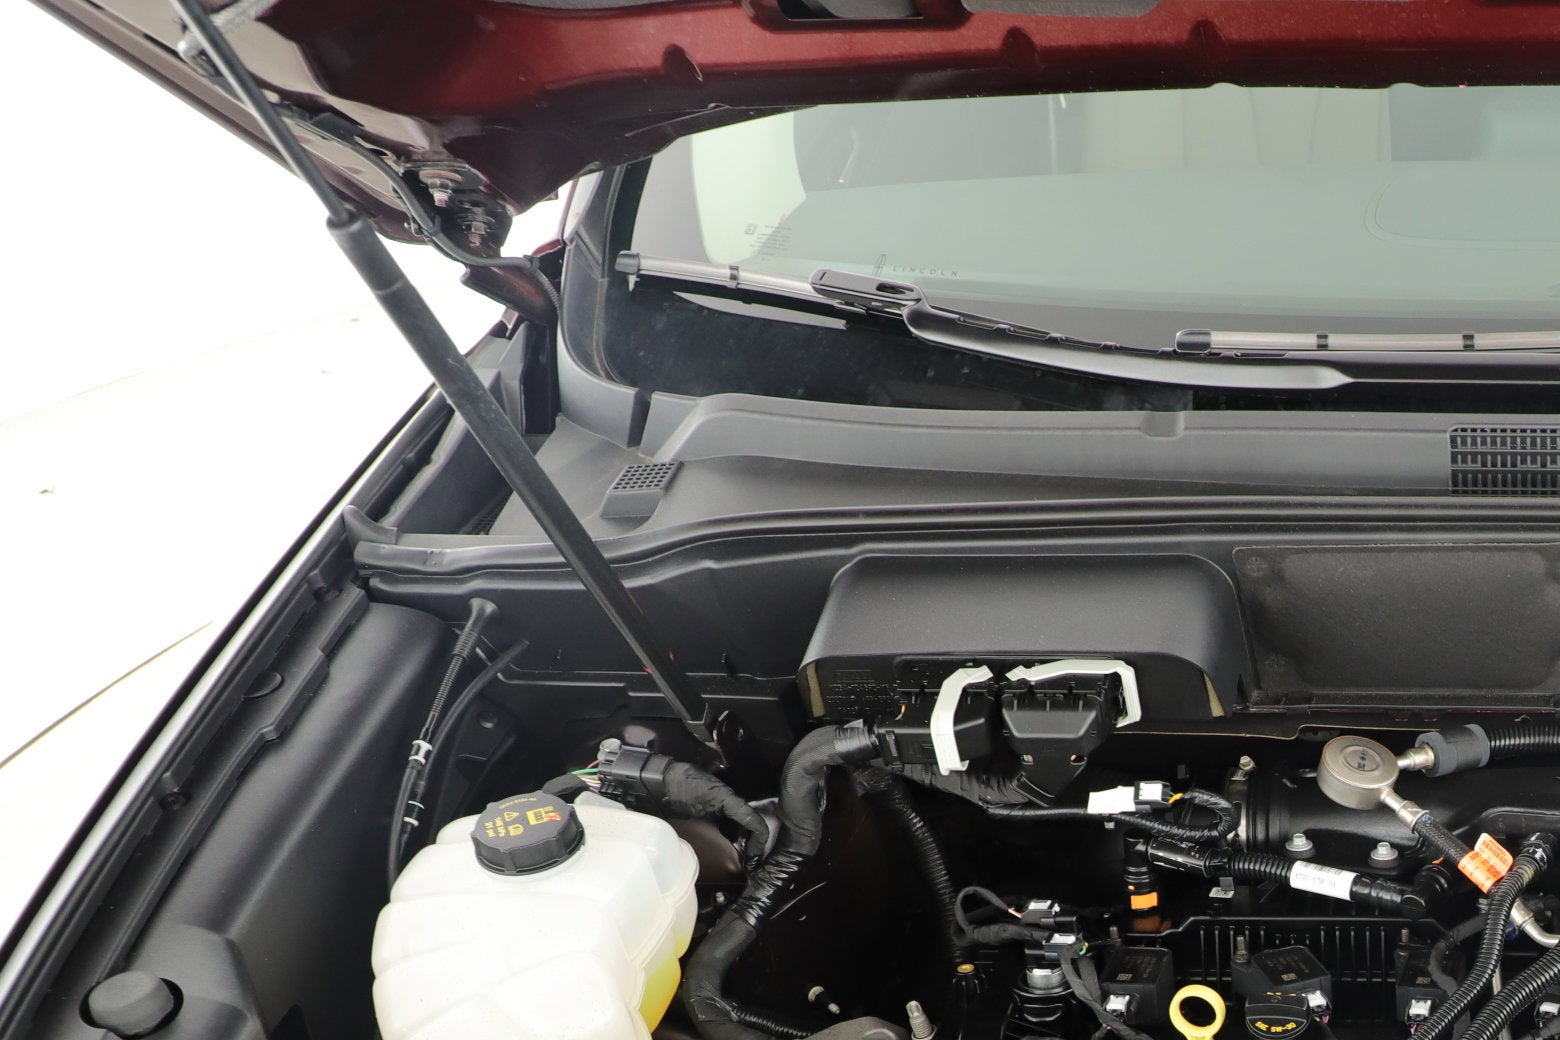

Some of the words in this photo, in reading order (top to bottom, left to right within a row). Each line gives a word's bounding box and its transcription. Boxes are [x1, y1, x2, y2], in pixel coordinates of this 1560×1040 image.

[891, 265, 960, 277] LINCOLN
[1254, 1021, 1269, 1031] SAE
[1270, 1022, 1297, 1033] 5W-30
